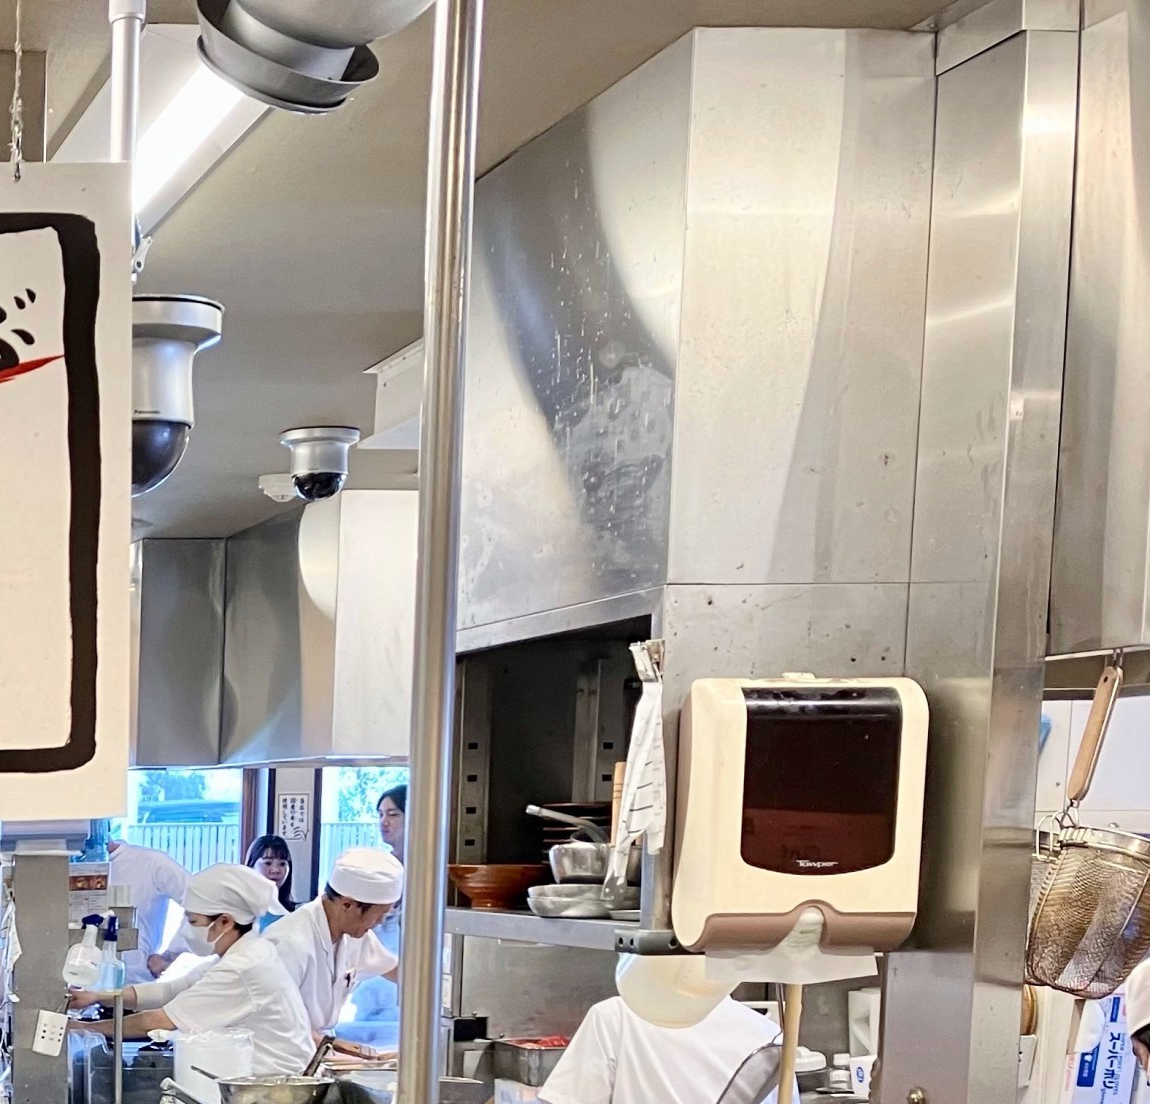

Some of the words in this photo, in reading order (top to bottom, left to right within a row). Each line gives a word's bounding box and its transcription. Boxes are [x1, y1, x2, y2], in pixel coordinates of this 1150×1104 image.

[1103, 1032, 1121, 1089] スーパーポリ
